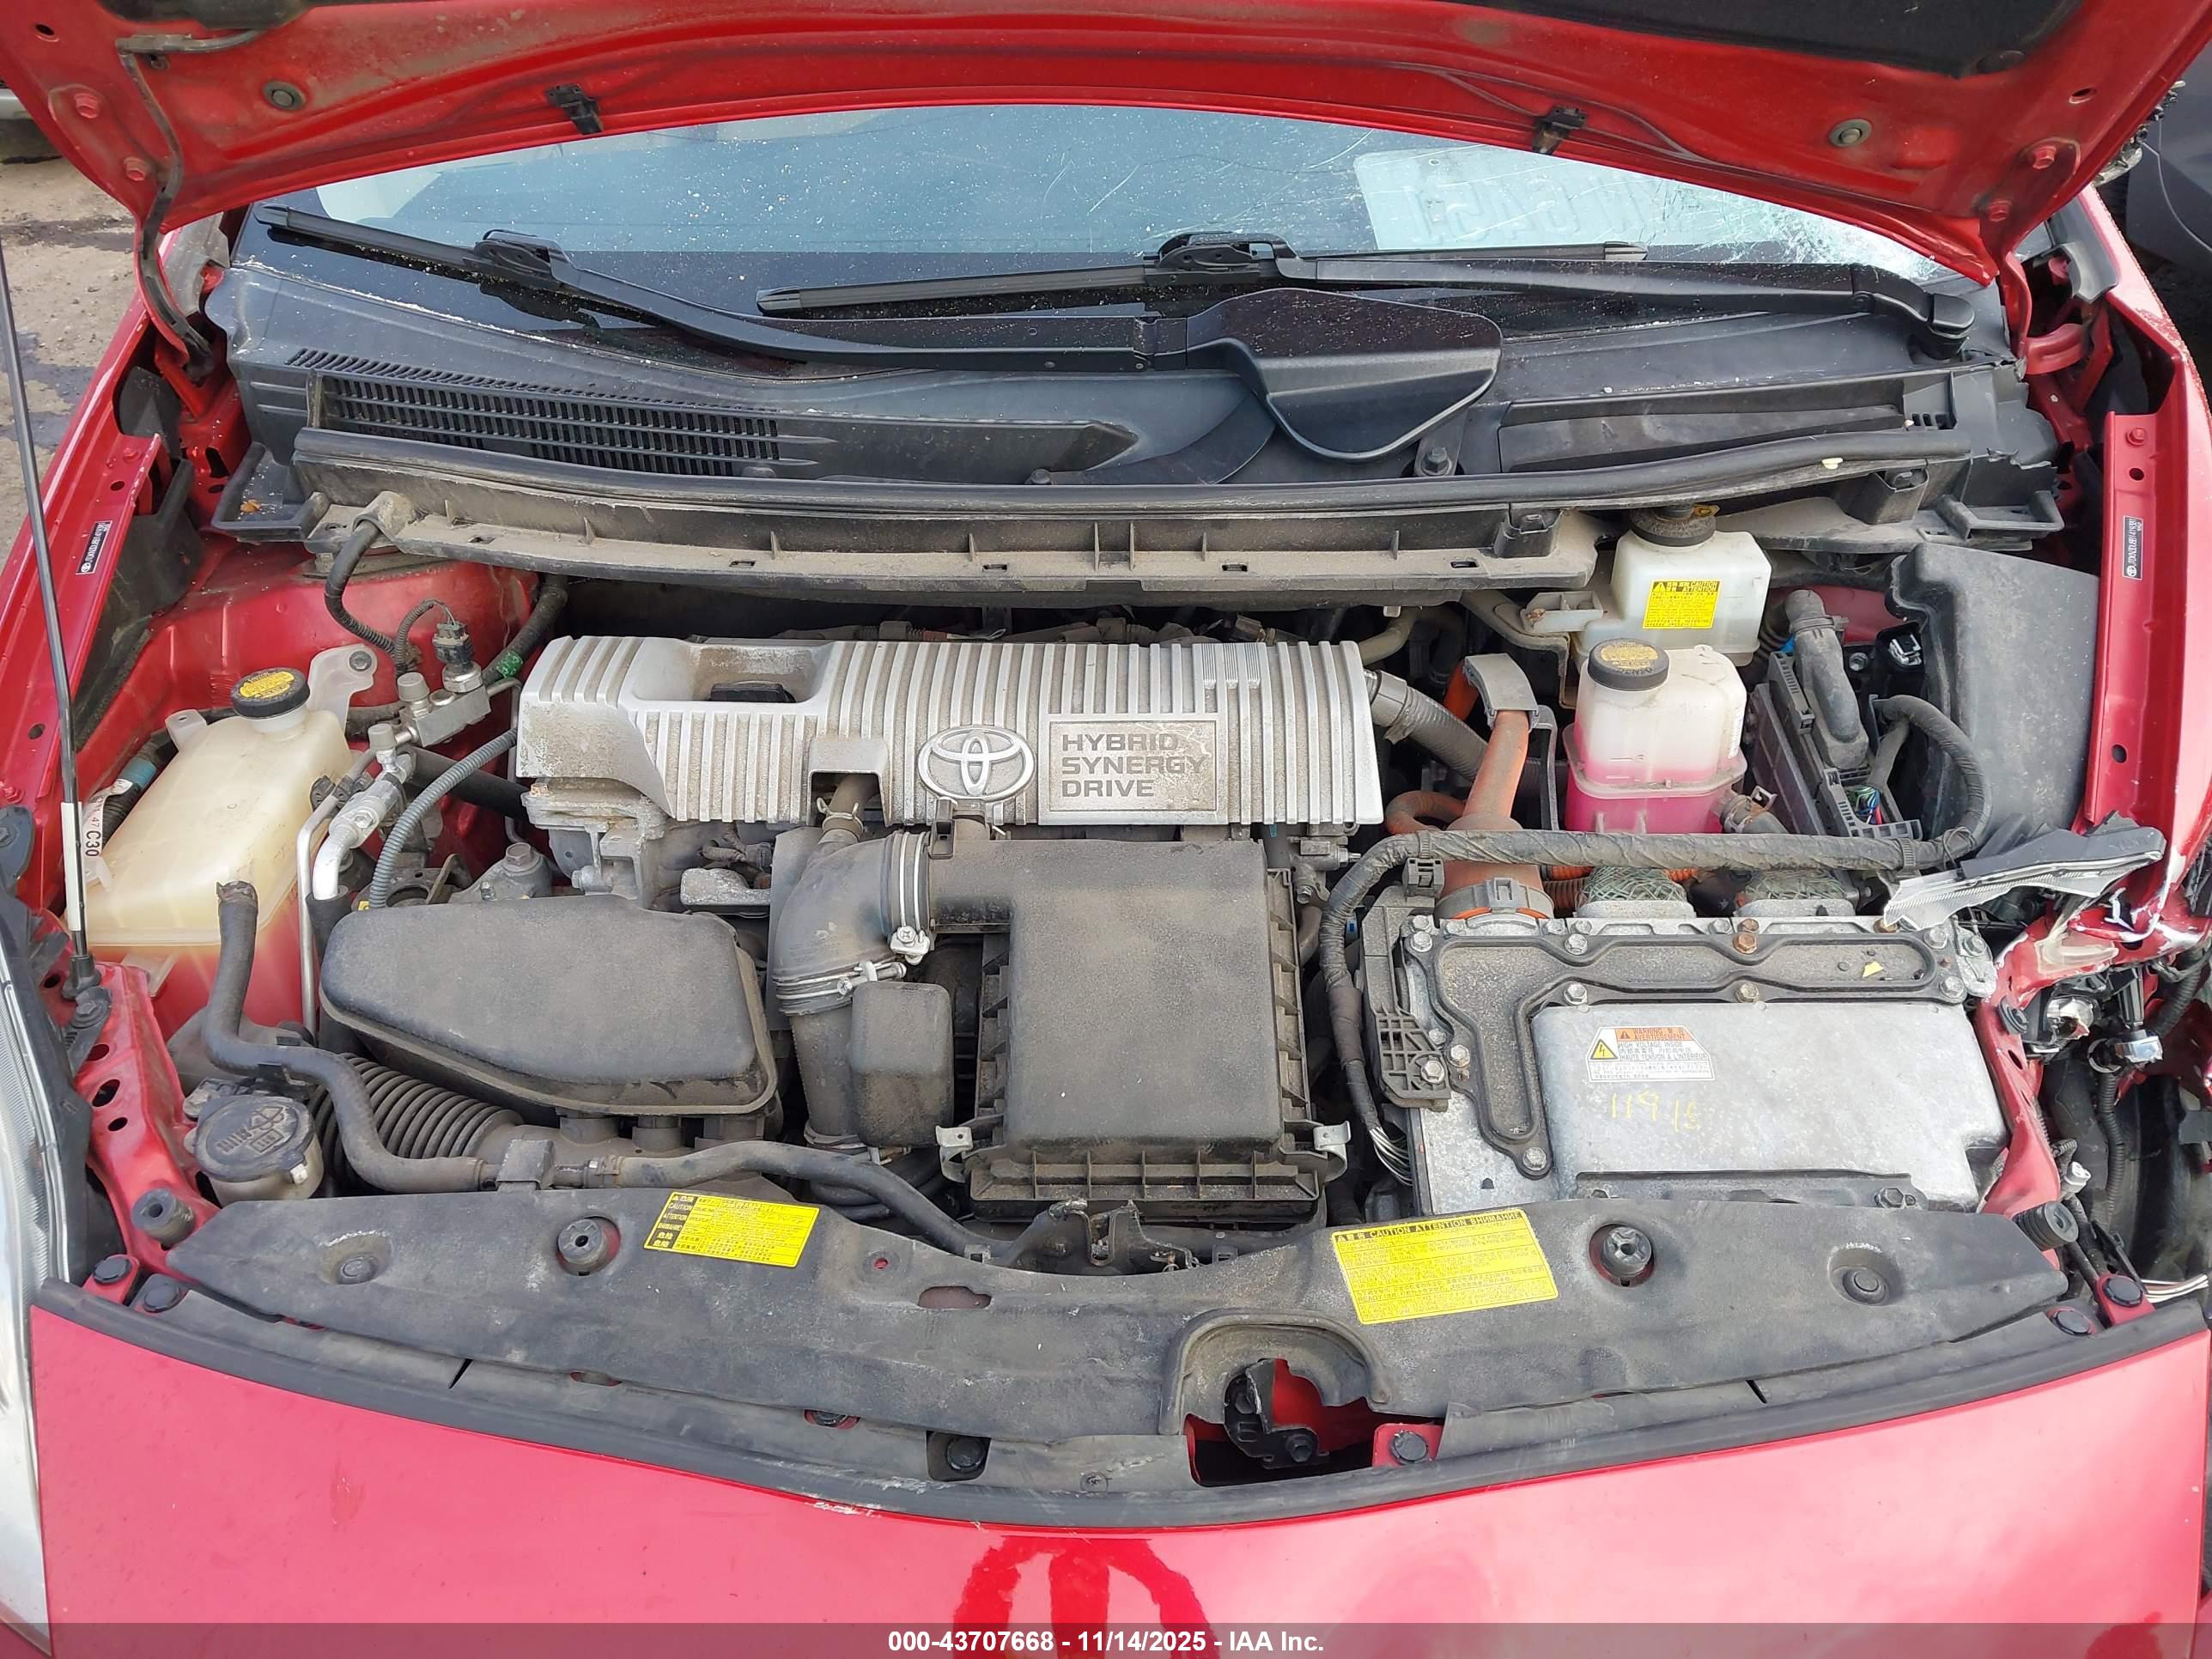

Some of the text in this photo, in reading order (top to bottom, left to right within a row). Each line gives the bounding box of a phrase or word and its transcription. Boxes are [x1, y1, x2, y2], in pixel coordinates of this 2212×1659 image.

[1062, 733, 1178, 751] HYBRID
[1061, 756, 1206, 775] SYNERGY
[1061, 780, 1155, 797] DRIVE
[85, 830, 101, 857] C30
[669, 1202, 693, 1211] CAUTION
[1370, 1227, 1411, 1238] CAUTION
[1415, 1219, 1467, 1233] ATTENTION
[1471, 1212, 1522, 1225] ВНИМАНИЕ
